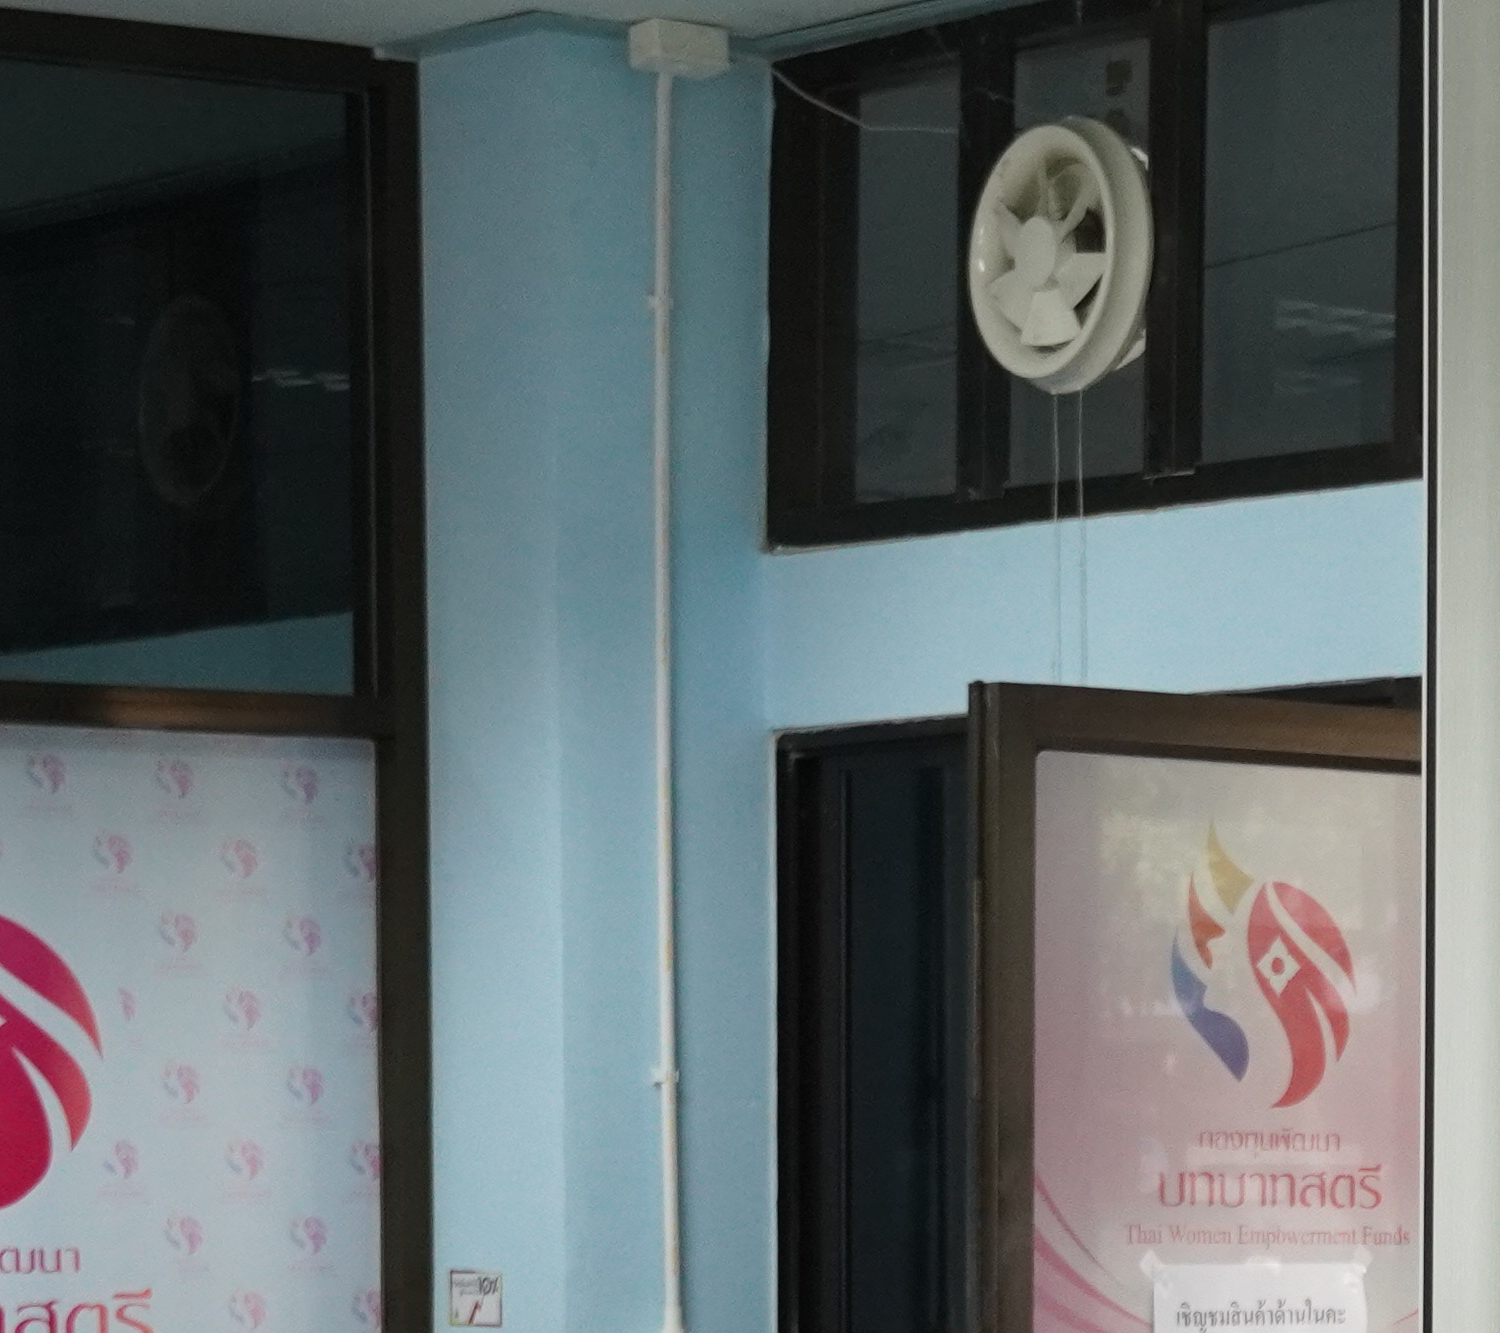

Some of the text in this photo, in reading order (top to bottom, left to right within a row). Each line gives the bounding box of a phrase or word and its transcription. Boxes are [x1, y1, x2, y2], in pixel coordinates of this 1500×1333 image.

[1197, 1127, 1342, 1159] กองทุนพัฒนา
[1156, 1163, 1383, 1210] บทบาทสตรี
[1125, 1222, 1412, 1251] Thai Women Empowerment Funds
